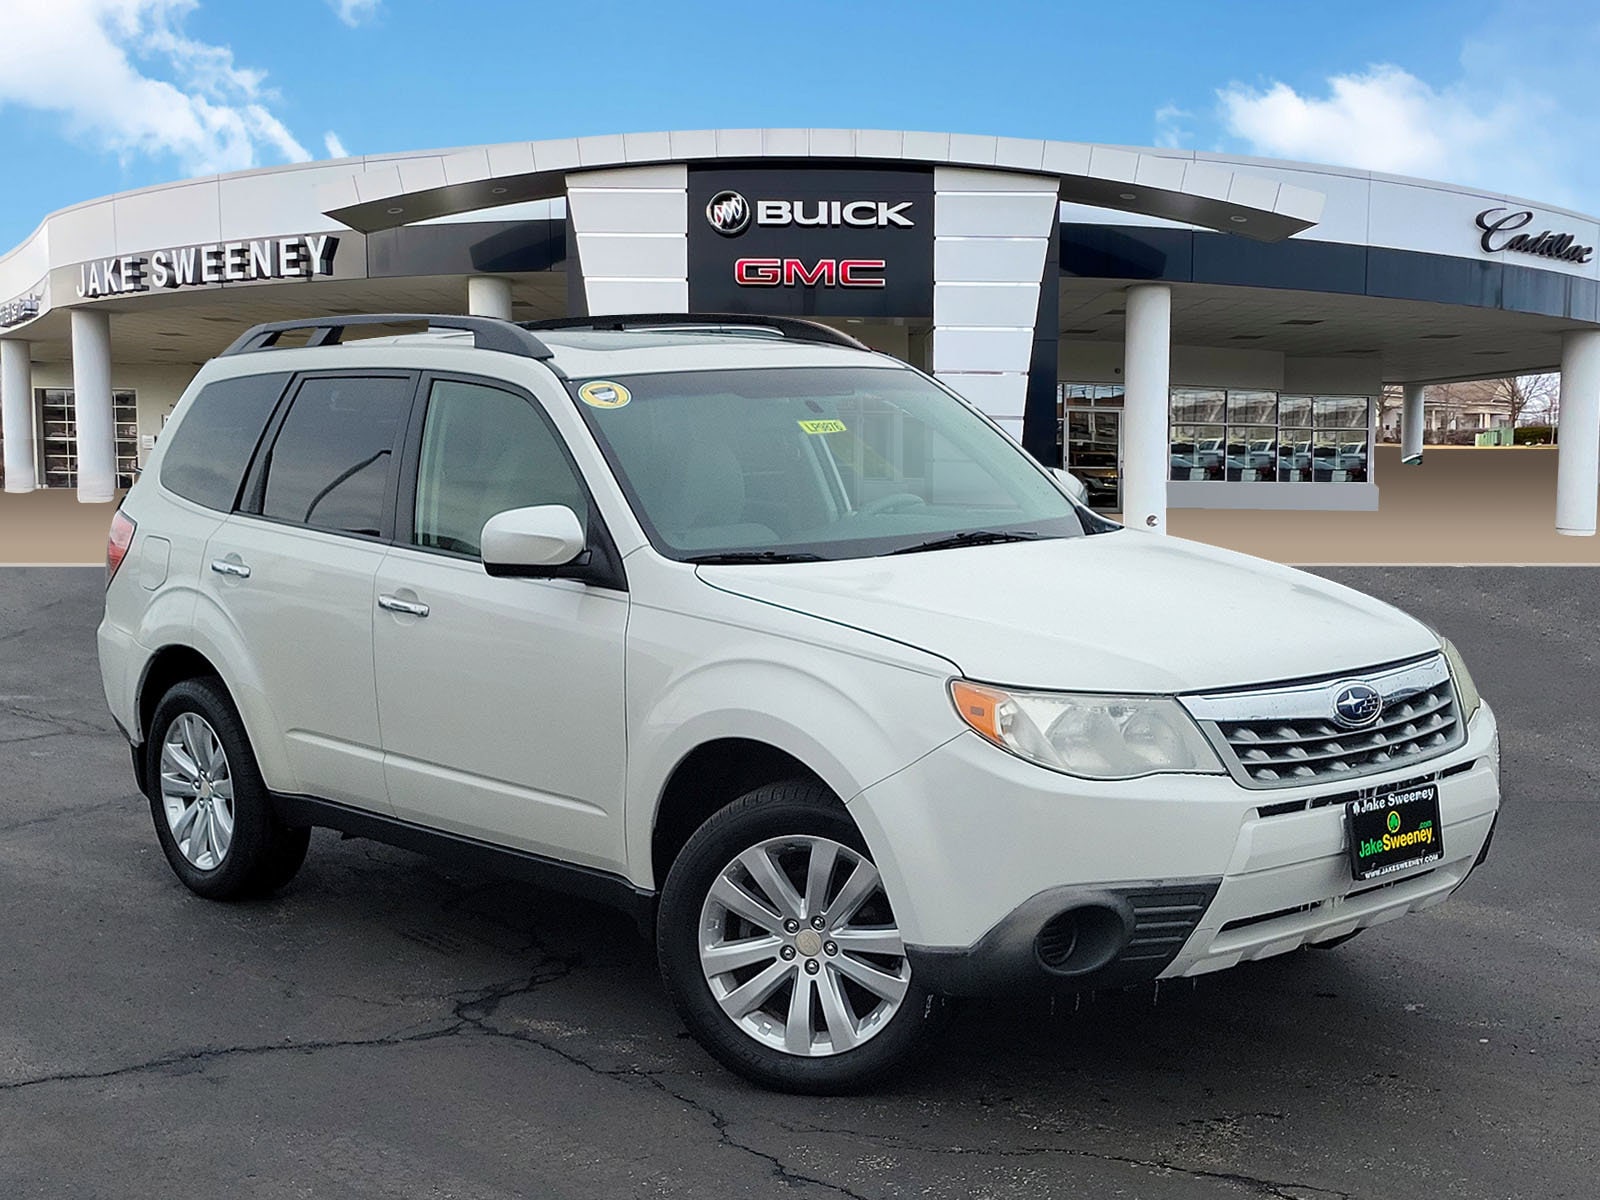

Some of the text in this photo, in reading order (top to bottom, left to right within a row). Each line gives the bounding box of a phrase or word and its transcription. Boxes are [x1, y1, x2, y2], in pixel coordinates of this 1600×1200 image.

[757, 201, 914, 226] BUICK
[1476, 207, 1593, 263] Cadillac
[76, 235, 337, 298] JAKE SWEENEY
[735, 258, 886, 287] GMC
[1361, 788, 1434, 813] Jake Sweeney
